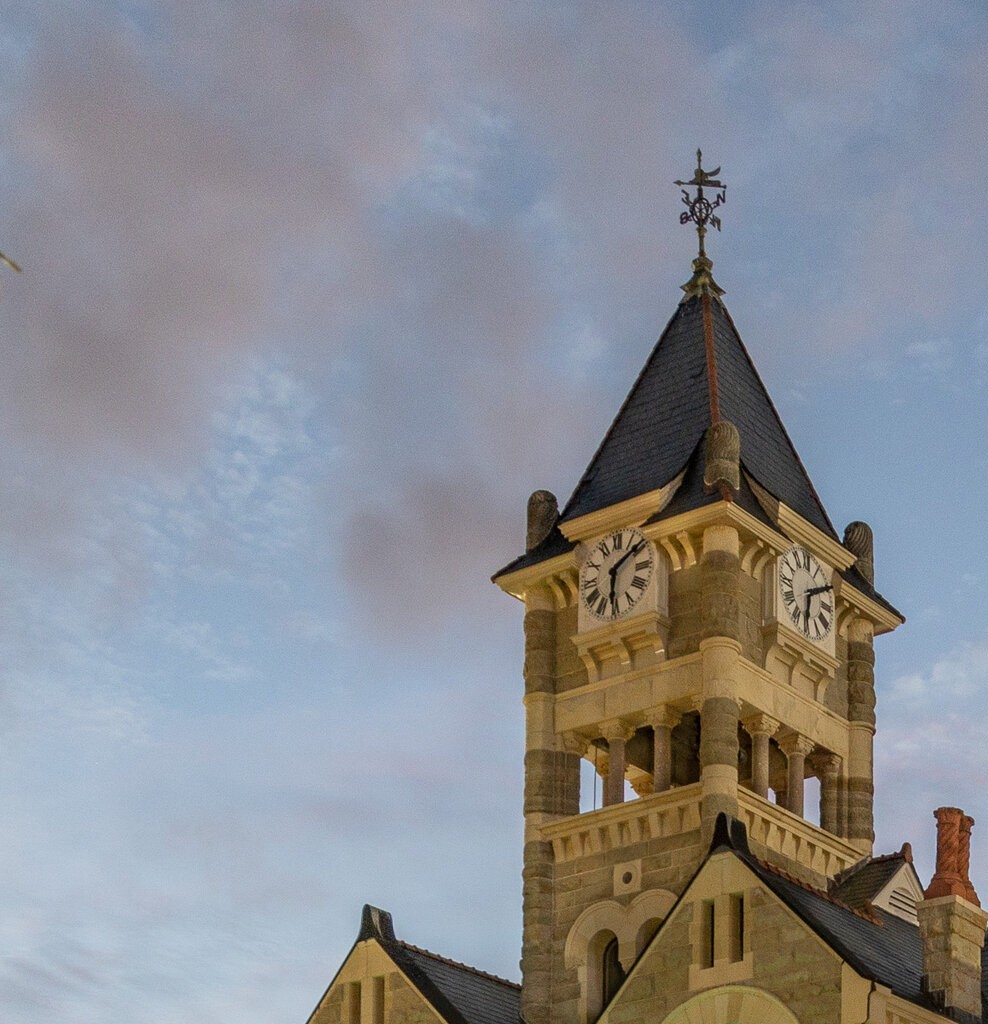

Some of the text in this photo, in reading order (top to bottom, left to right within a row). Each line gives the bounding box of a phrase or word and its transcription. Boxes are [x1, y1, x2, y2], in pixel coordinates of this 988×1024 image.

[612, 533, 622, 551] XII
[586, 561, 600, 570] X
[625, 592, 637, 606] V
